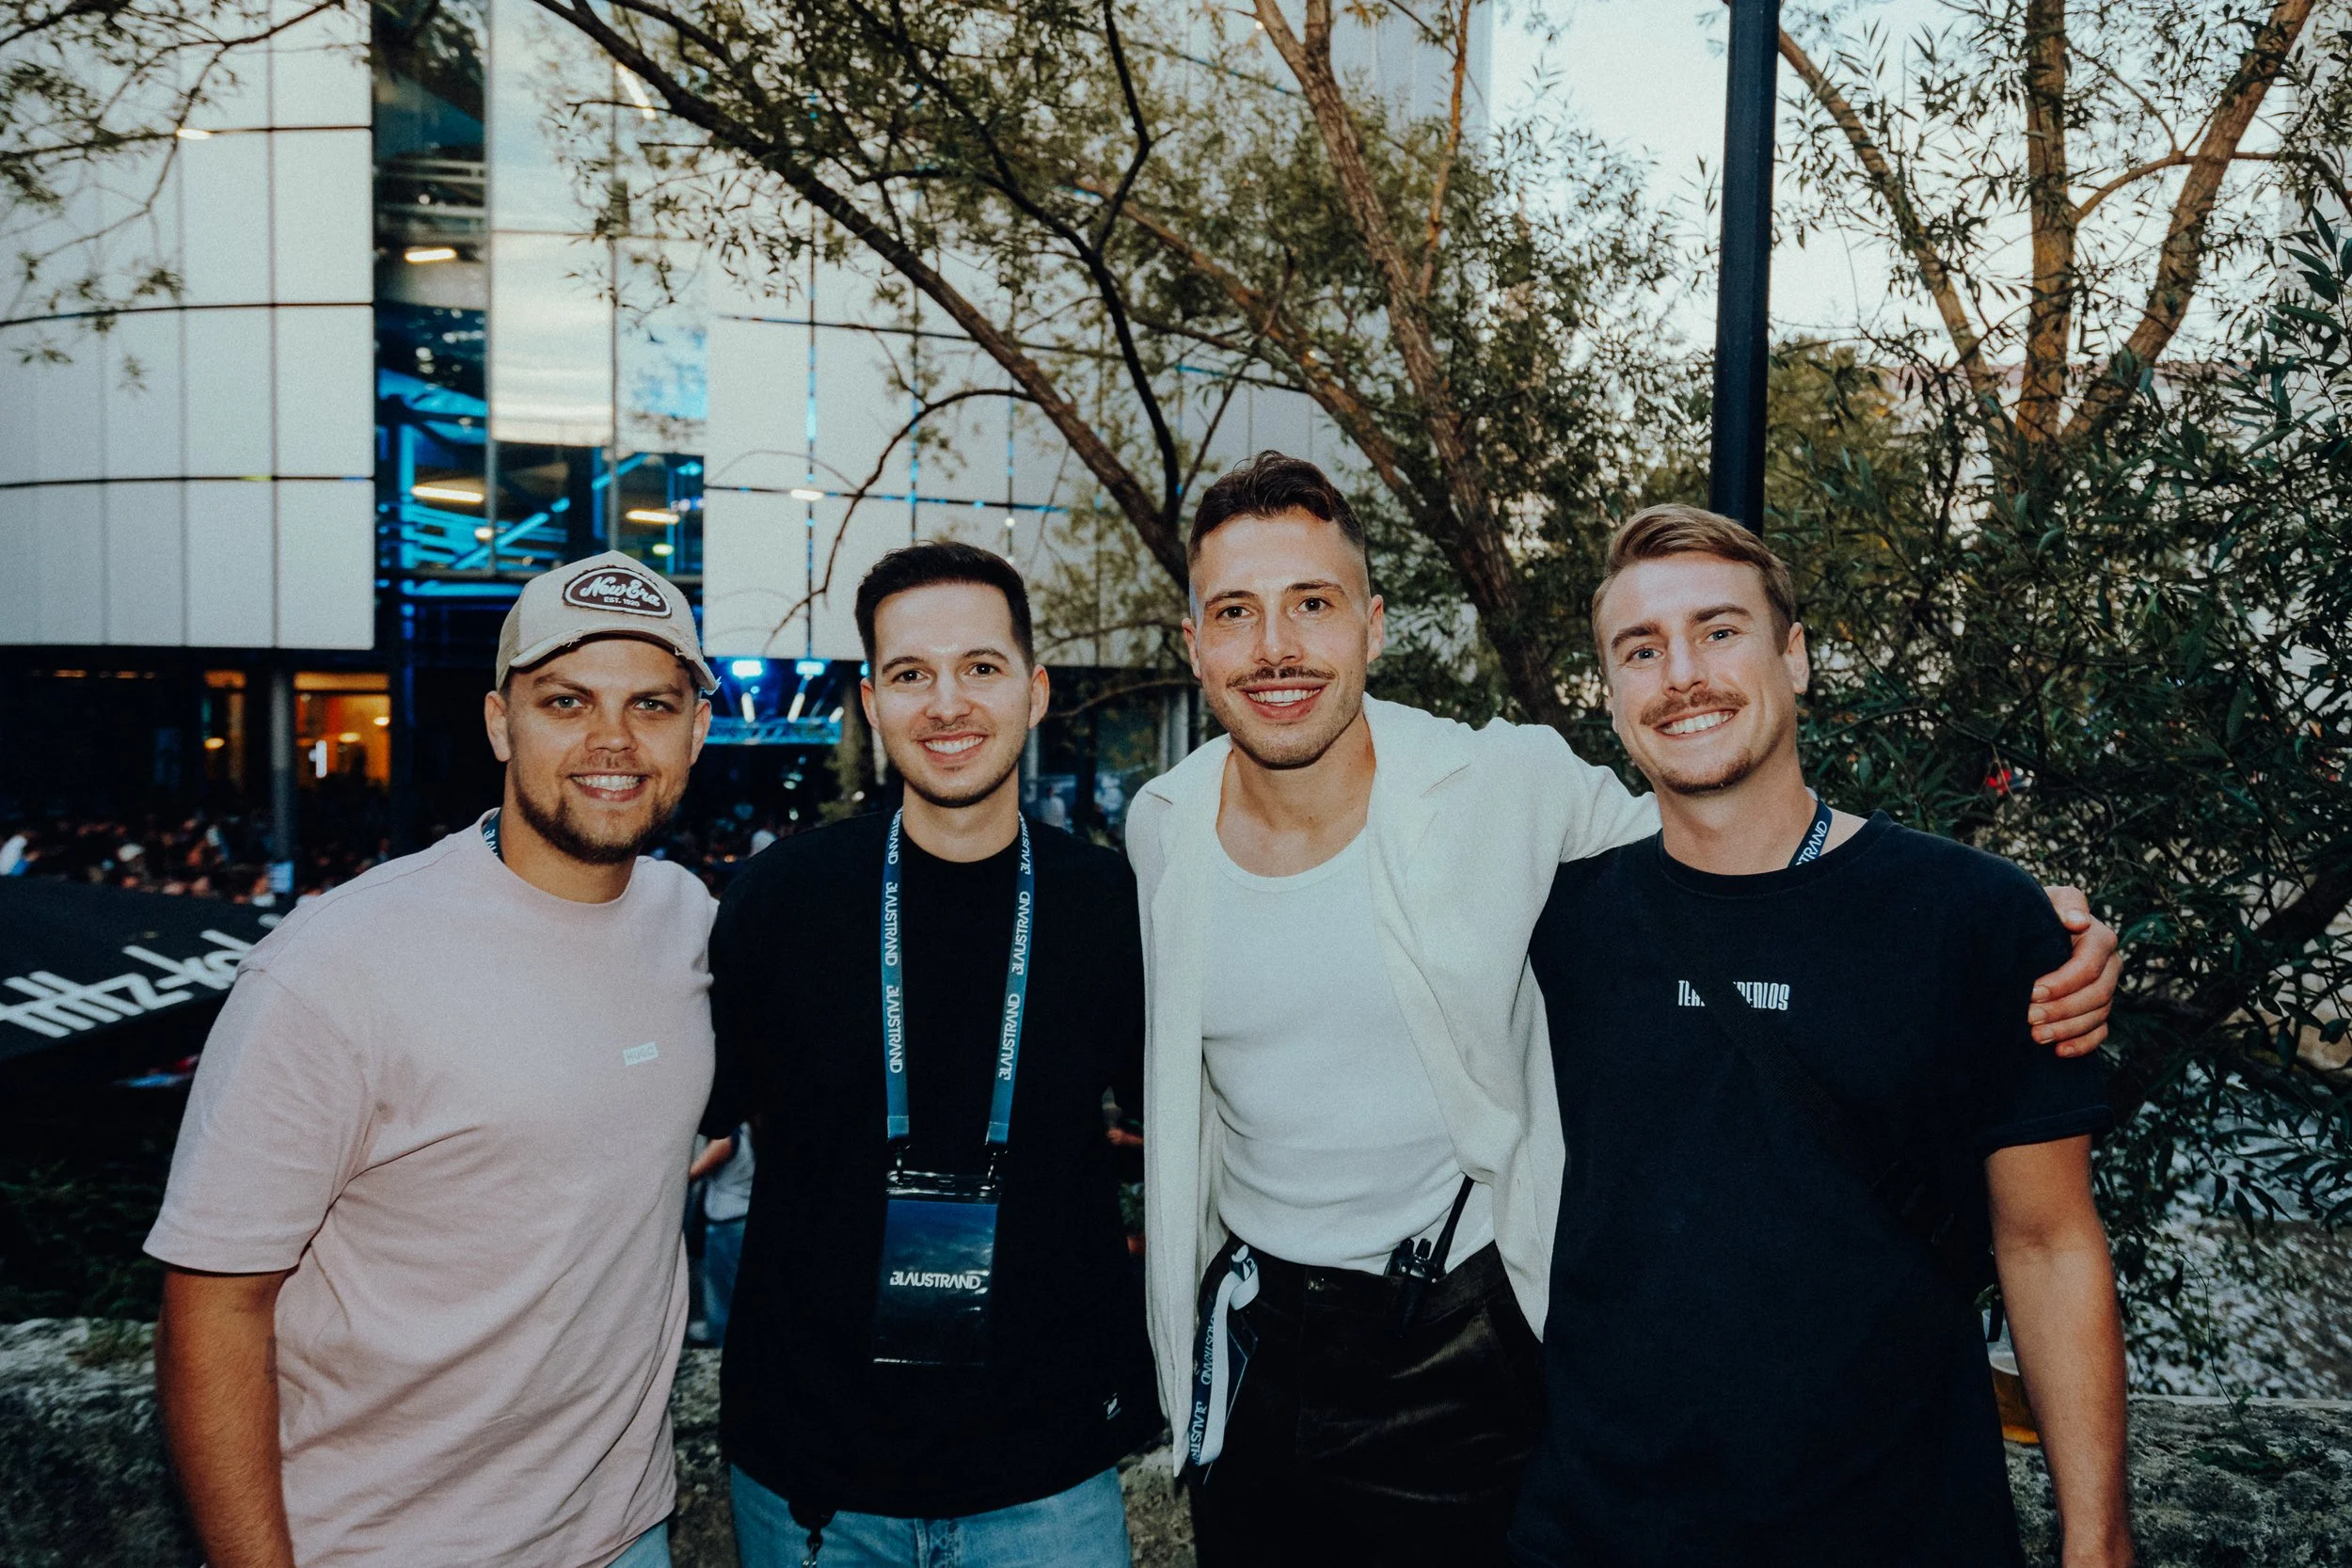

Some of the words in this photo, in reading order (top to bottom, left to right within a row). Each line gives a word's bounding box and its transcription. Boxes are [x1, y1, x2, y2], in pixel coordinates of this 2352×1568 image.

[603, 595, 622, 604] EST.
[887, 806, 903, 865] USTRAND
[1795, 820, 1828, 866] TRAND
[884, 881, 898, 967] BLAUSTRAND
[1011, 890, 1031, 976] BLAUSTRAND
[885, 985, 903, 1074] BLAUSTRAND
[998, 992, 1021, 1082] BLAUSTRAND
[889, 1271, 982, 1290] BLAUSTRAND
